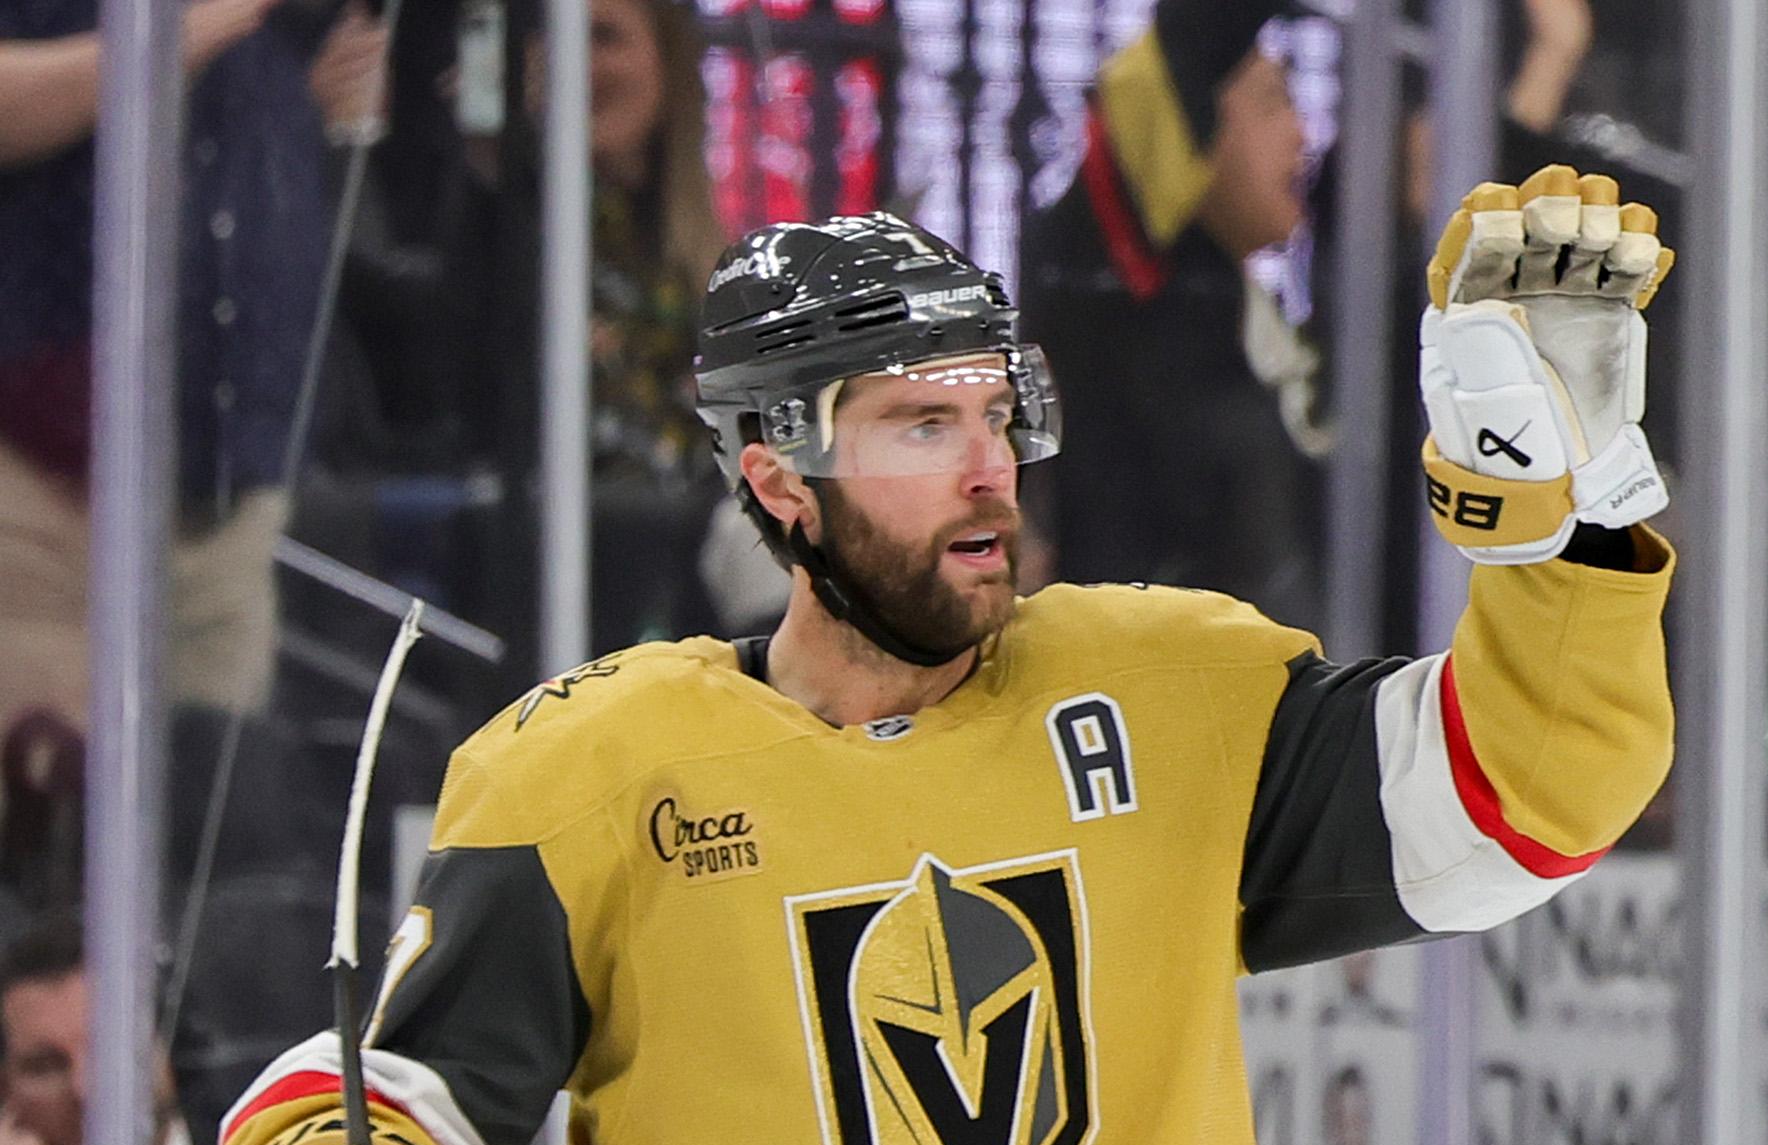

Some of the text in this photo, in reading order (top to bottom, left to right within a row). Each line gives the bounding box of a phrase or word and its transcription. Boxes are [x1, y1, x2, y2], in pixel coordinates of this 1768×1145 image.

[1045, 692, 1138, 822] A
[649, 797, 753, 863] Circa
[683, 840, 759, 877] SPORTS
